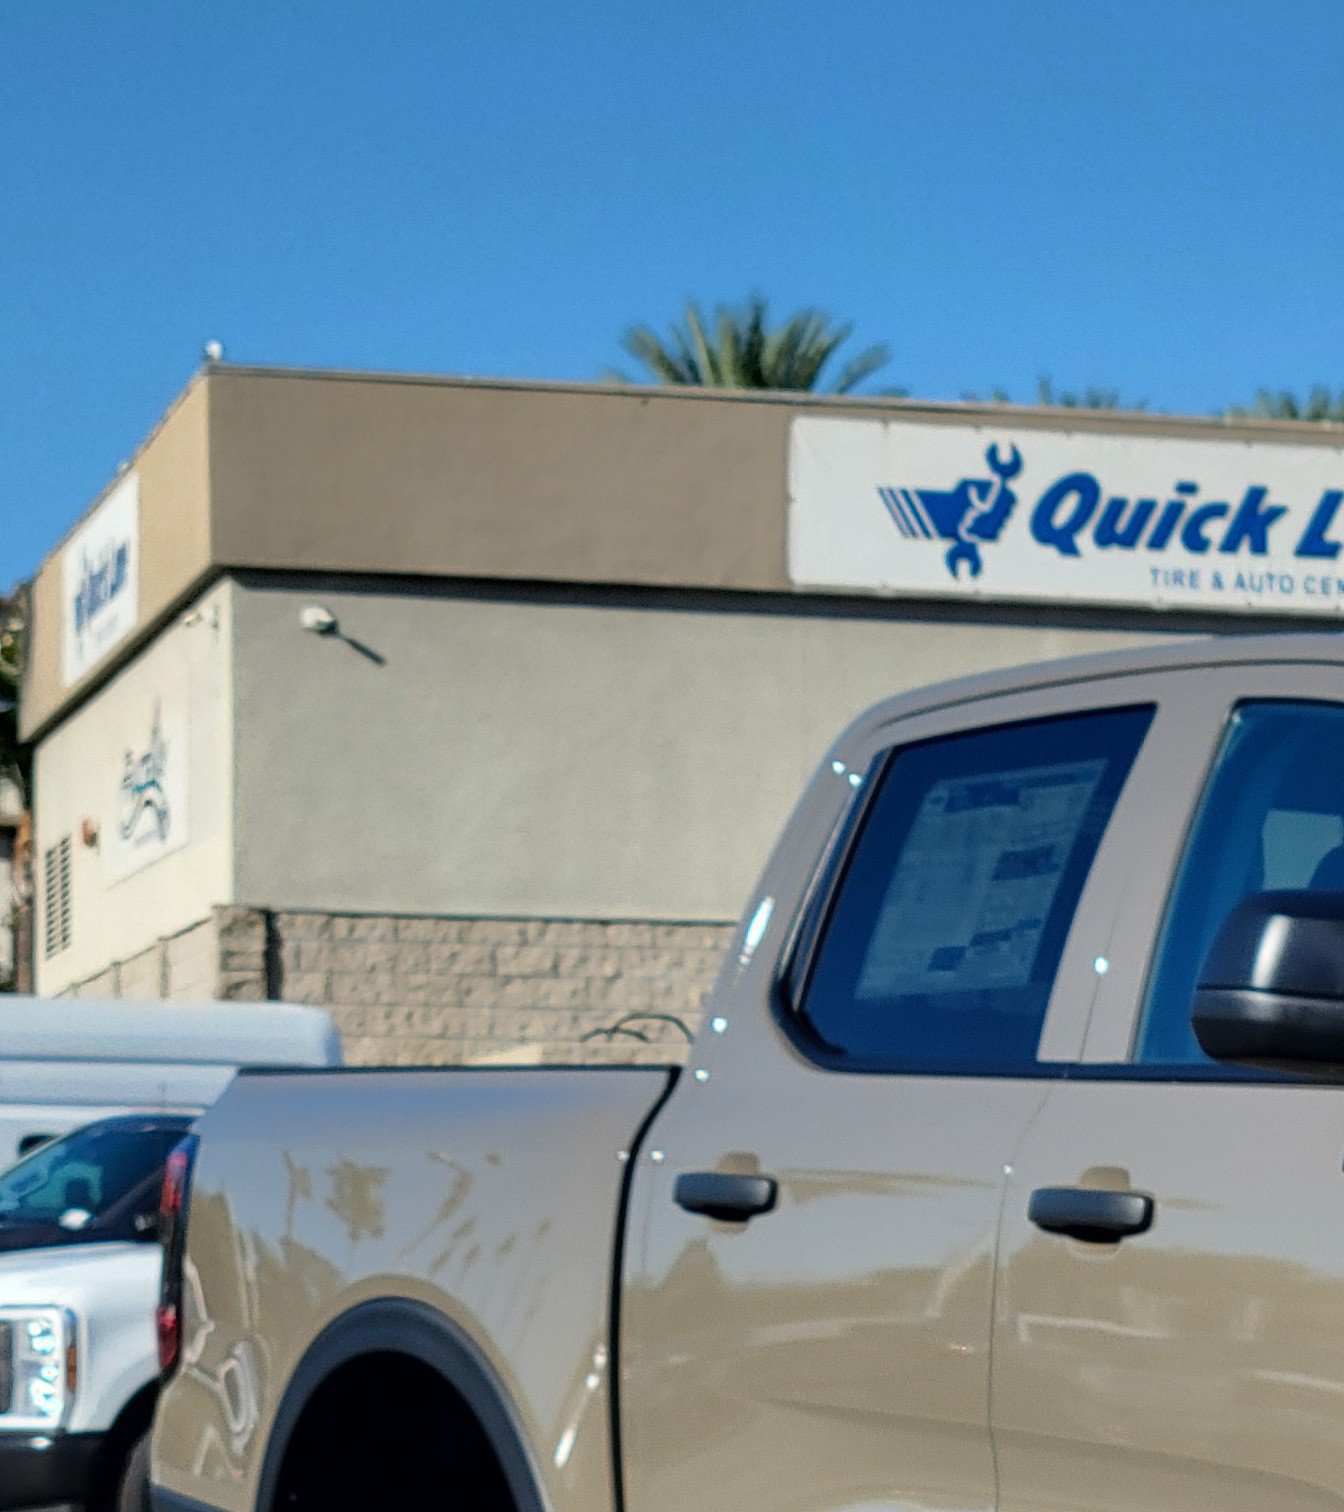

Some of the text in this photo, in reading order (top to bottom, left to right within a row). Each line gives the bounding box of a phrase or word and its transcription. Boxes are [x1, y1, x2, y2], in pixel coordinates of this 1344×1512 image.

[1030, 472, 1287, 558] Quick
[1150, 566, 1199, 591] TIRE
[1210, 568, 1225, 590] &
[1234, 570, 1295, 595] AUTO
